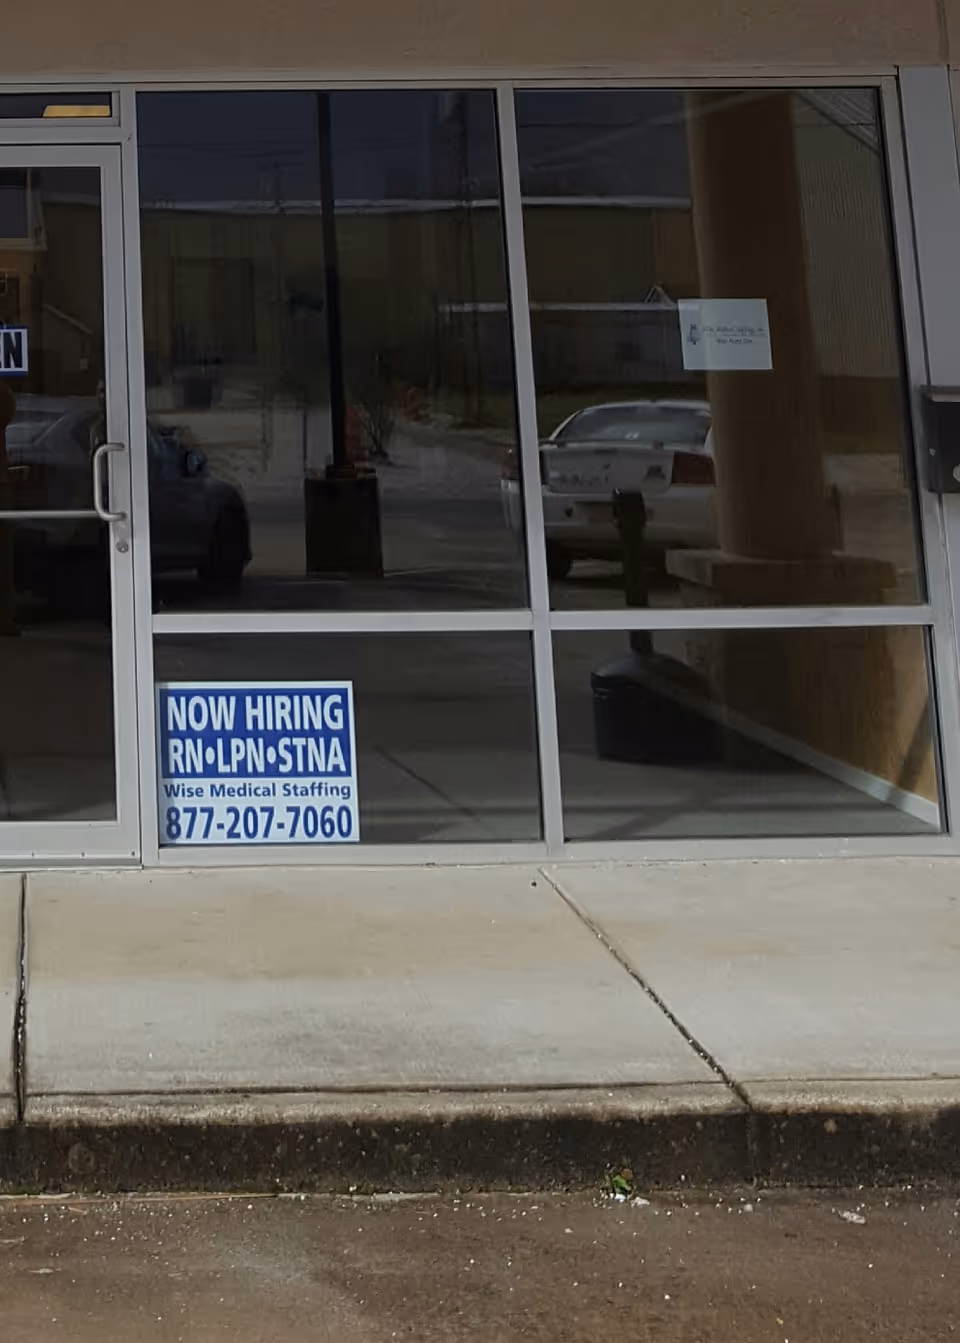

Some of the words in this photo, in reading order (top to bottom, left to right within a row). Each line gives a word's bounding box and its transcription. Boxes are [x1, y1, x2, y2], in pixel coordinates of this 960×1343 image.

[167, 695, 237, 732] NOW
[245, 694, 344, 731] HIRING
[163, 783, 205, 798] Wise
[209, 782, 277, 798] Medical
[282, 781, 352, 800] Staffing
[165, 805, 353, 841] 877-207-7060
